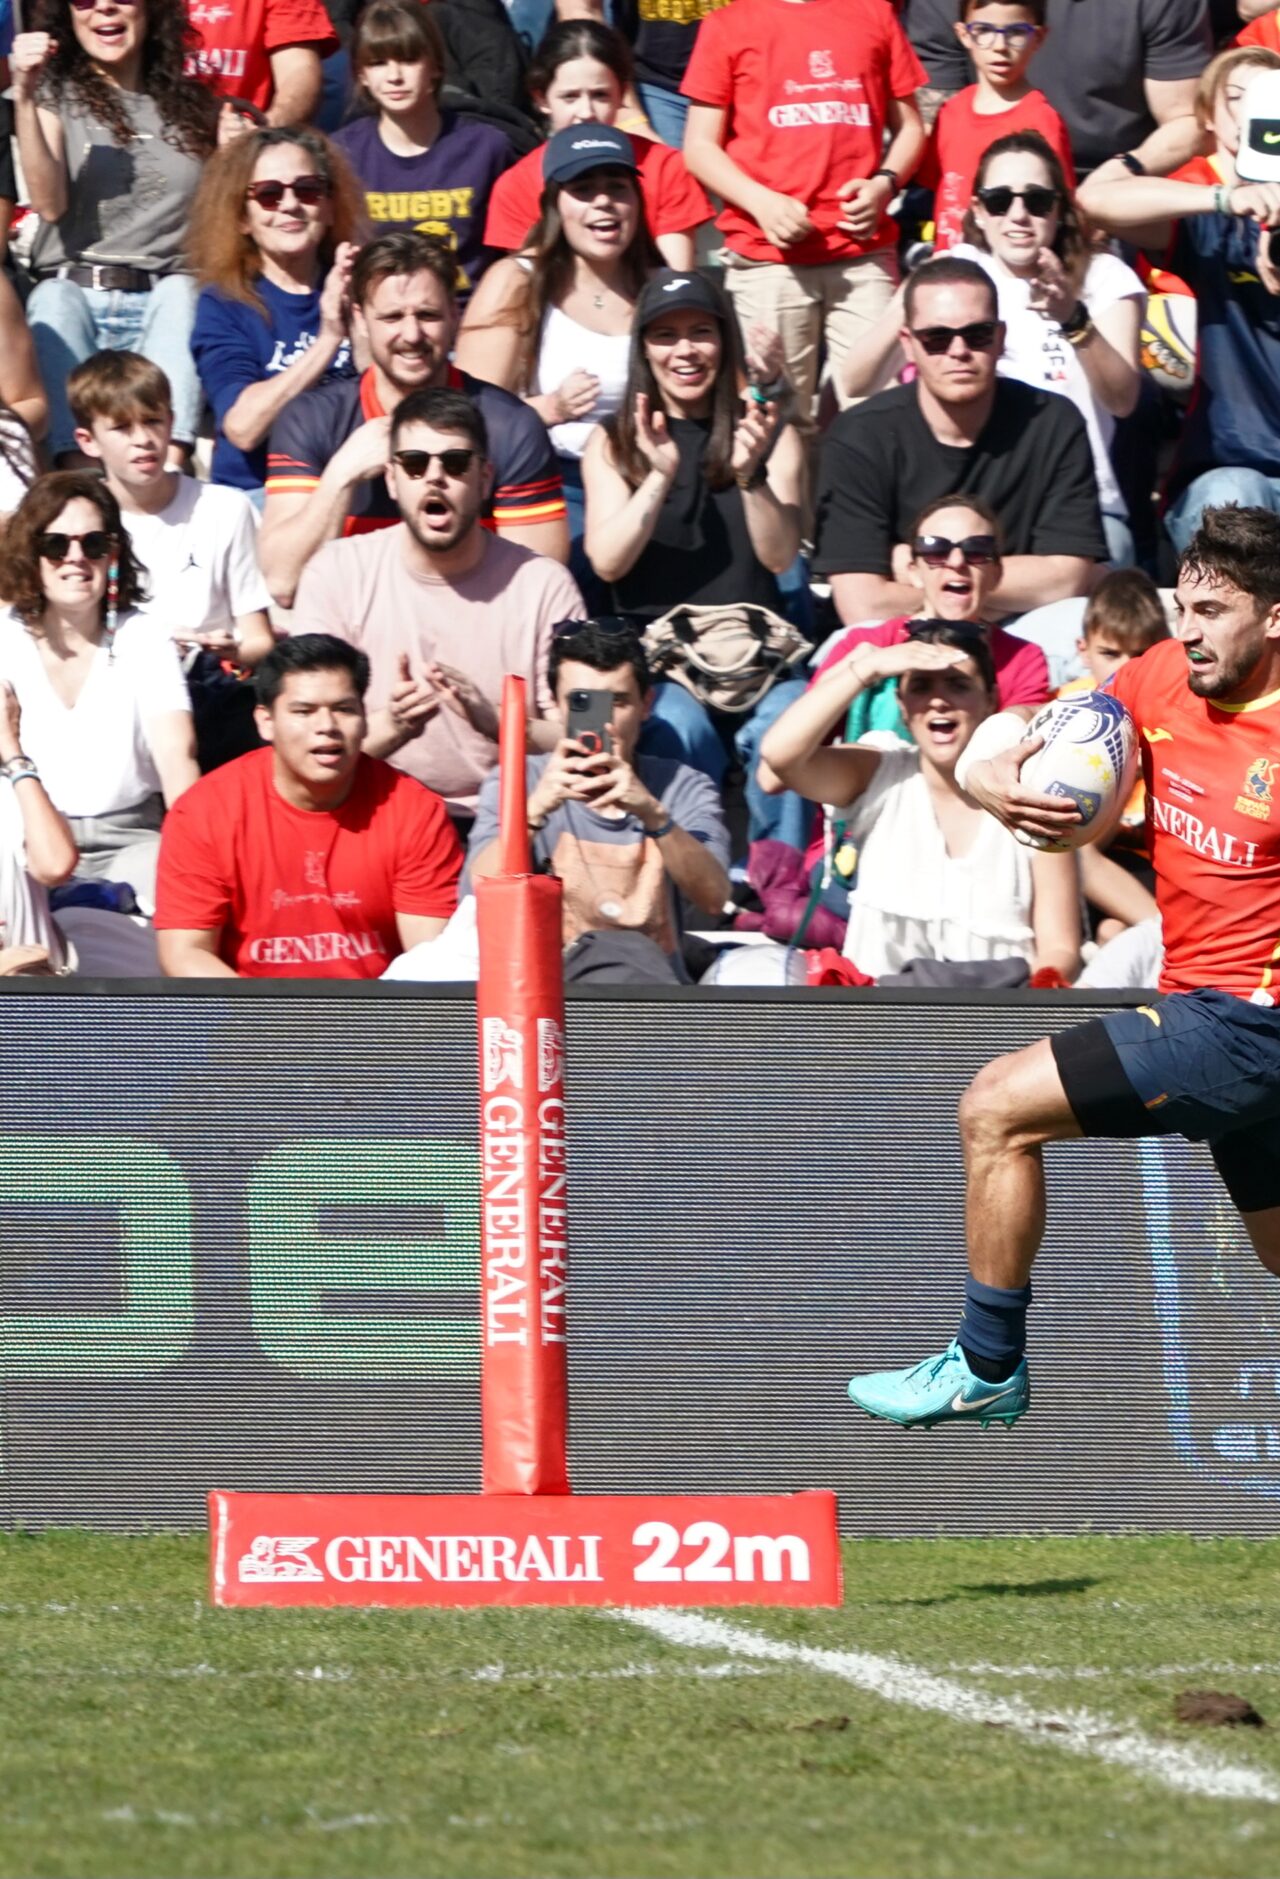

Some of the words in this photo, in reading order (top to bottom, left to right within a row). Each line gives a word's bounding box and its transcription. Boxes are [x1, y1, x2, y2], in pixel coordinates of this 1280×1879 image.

[364, 187, 474, 222] RUGBY
[251, 932, 386, 964] GENERALI
[483, 1096, 528, 1347] GENERALI
[537, 1097, 567, 1347] GENERALI
[324, 1535, 603, 1582] GENERALI
[632, 1521, 811, 1583] 22m
